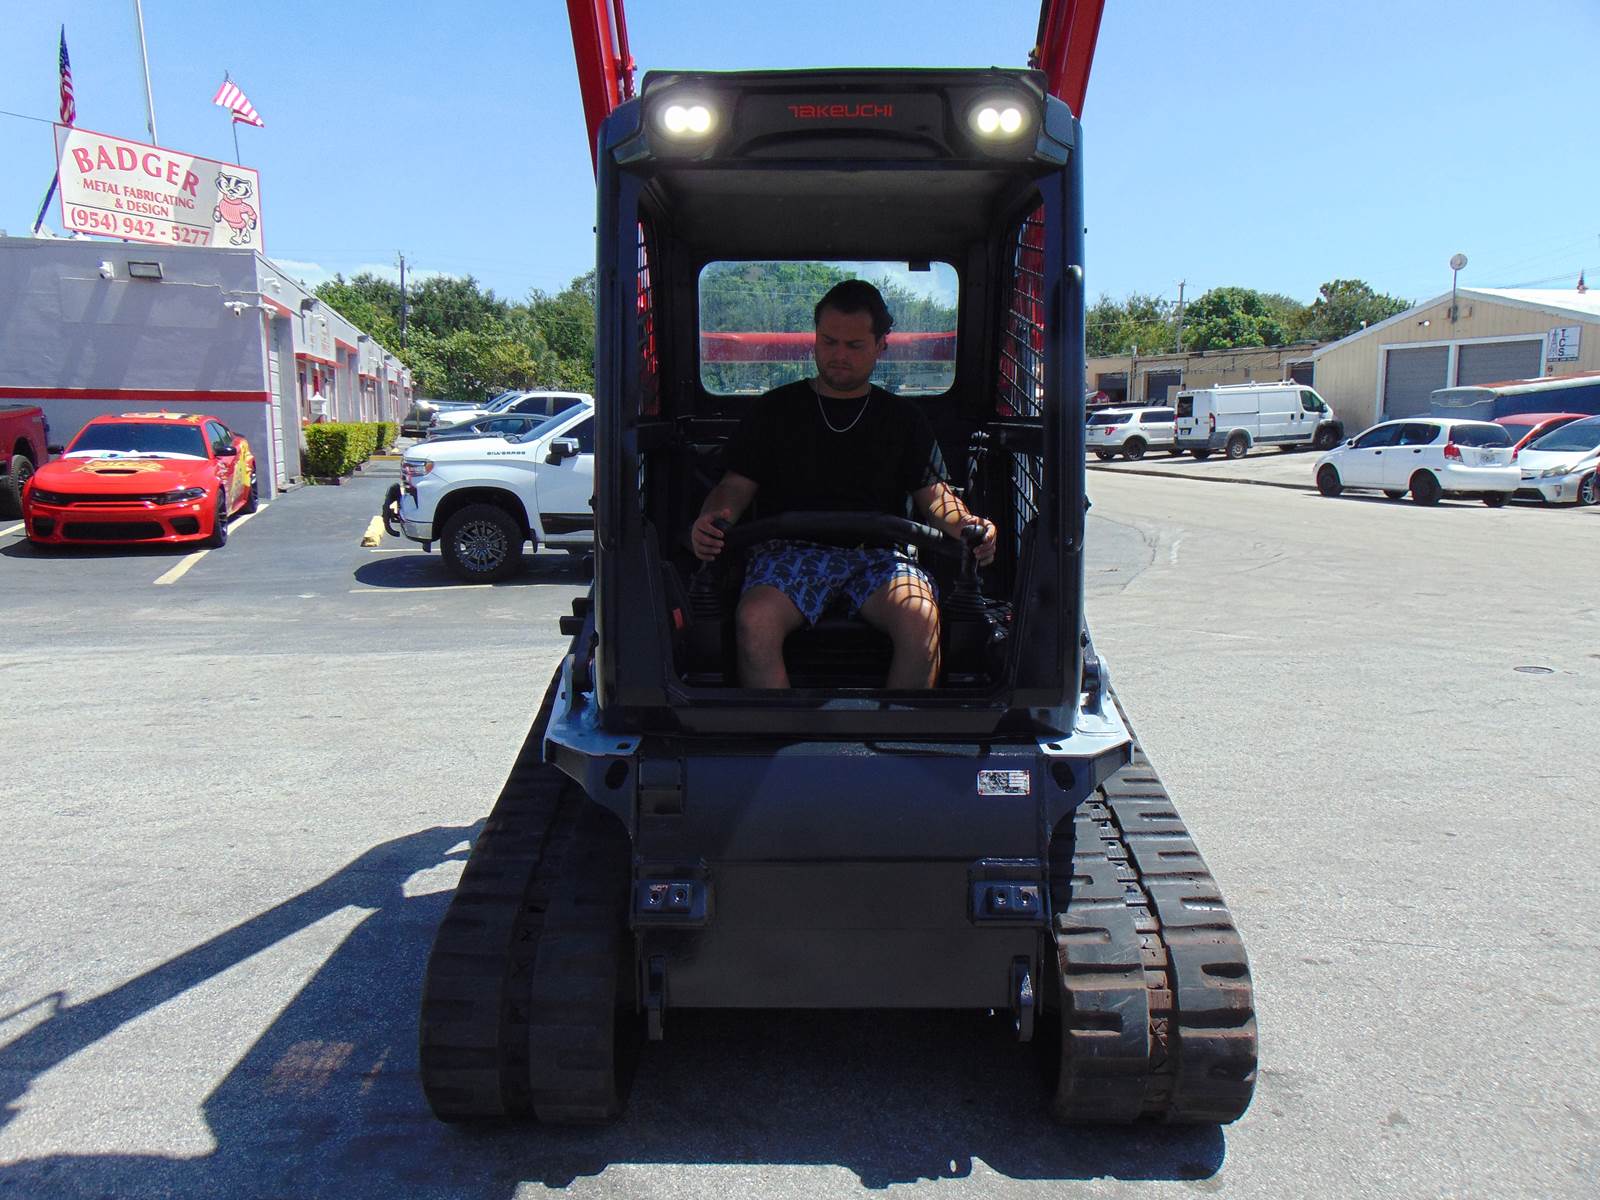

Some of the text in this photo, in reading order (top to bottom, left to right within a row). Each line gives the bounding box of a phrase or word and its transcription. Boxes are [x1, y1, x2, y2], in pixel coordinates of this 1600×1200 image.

[71, 144, 200, 197] BADGER
[83, 178, 195, 209] METAL FABRICATING
[114, 198, 169, 217] & DESIGN
[71, 207, 118, 232] (954)
[123, 217, 156, 238] 942
[171, 225, 210, 246] 5277
